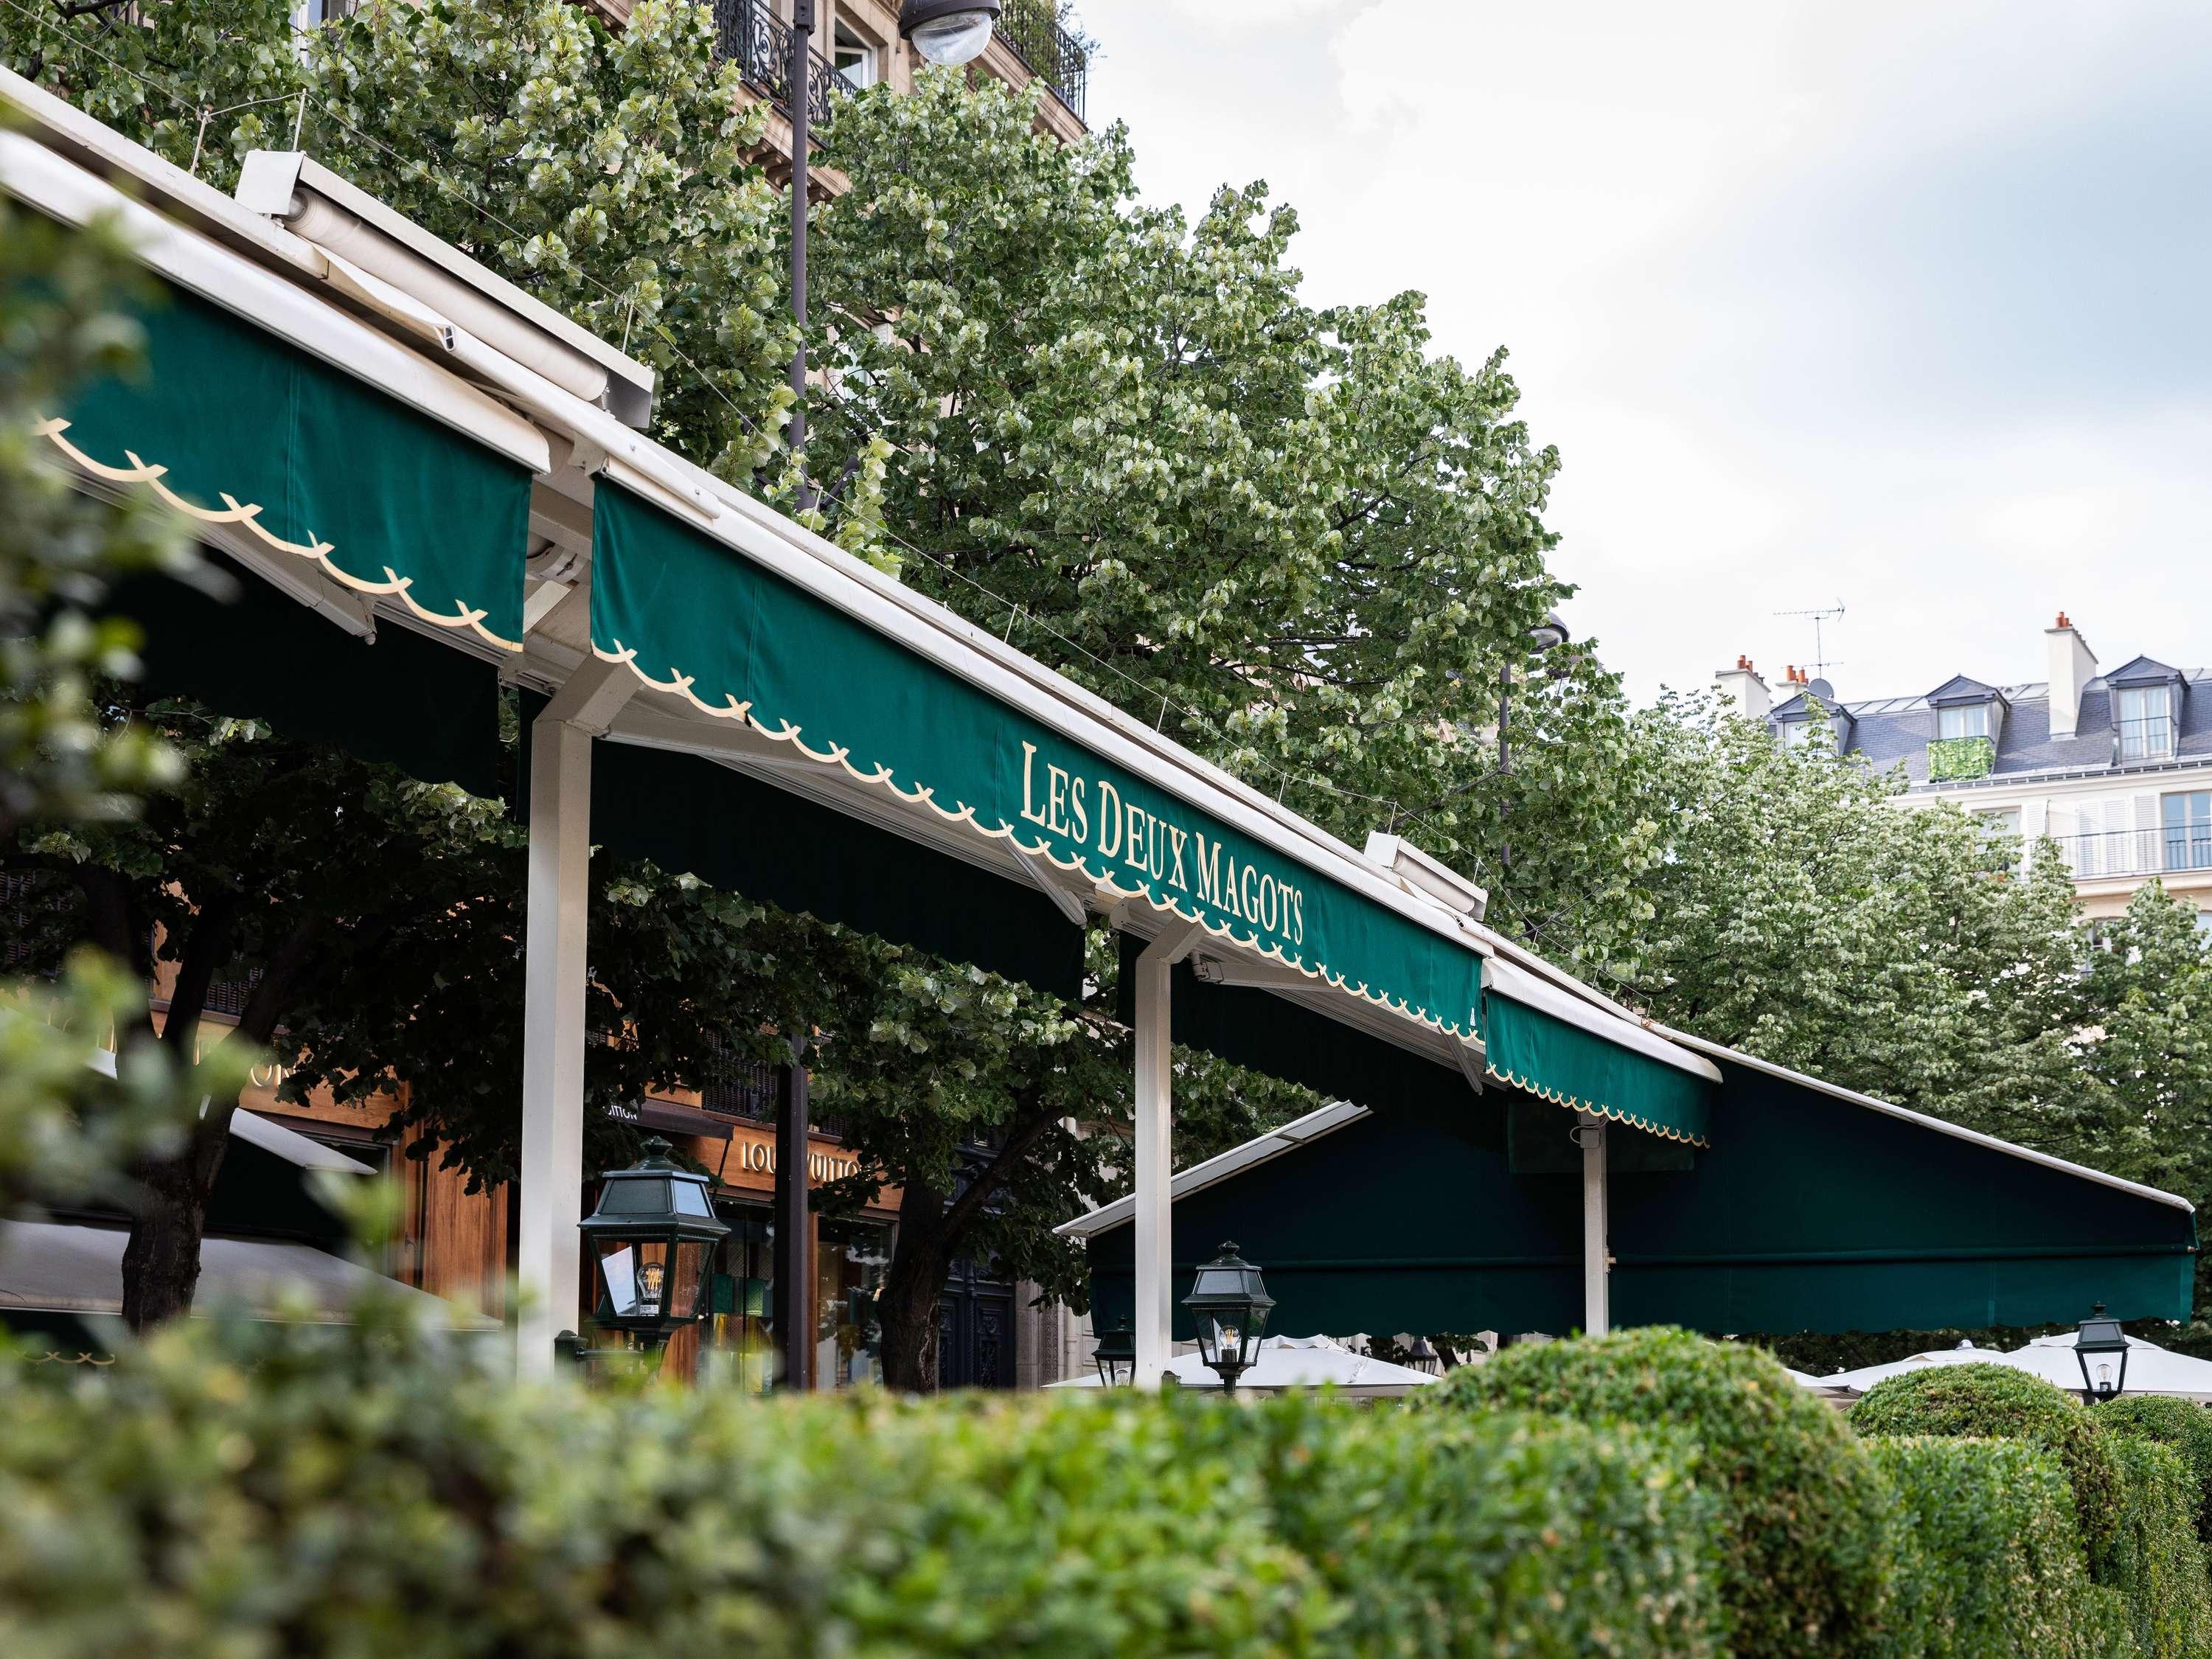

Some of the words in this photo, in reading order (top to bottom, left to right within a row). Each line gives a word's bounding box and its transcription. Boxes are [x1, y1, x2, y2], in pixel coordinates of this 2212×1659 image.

[1020, 740, 1088, 844] LES
[1098, 781, 1187, 892] DEUX
[1196, 832, 1303, 945] MAGOTS
[743, 1142, 776, 1173] LOU
